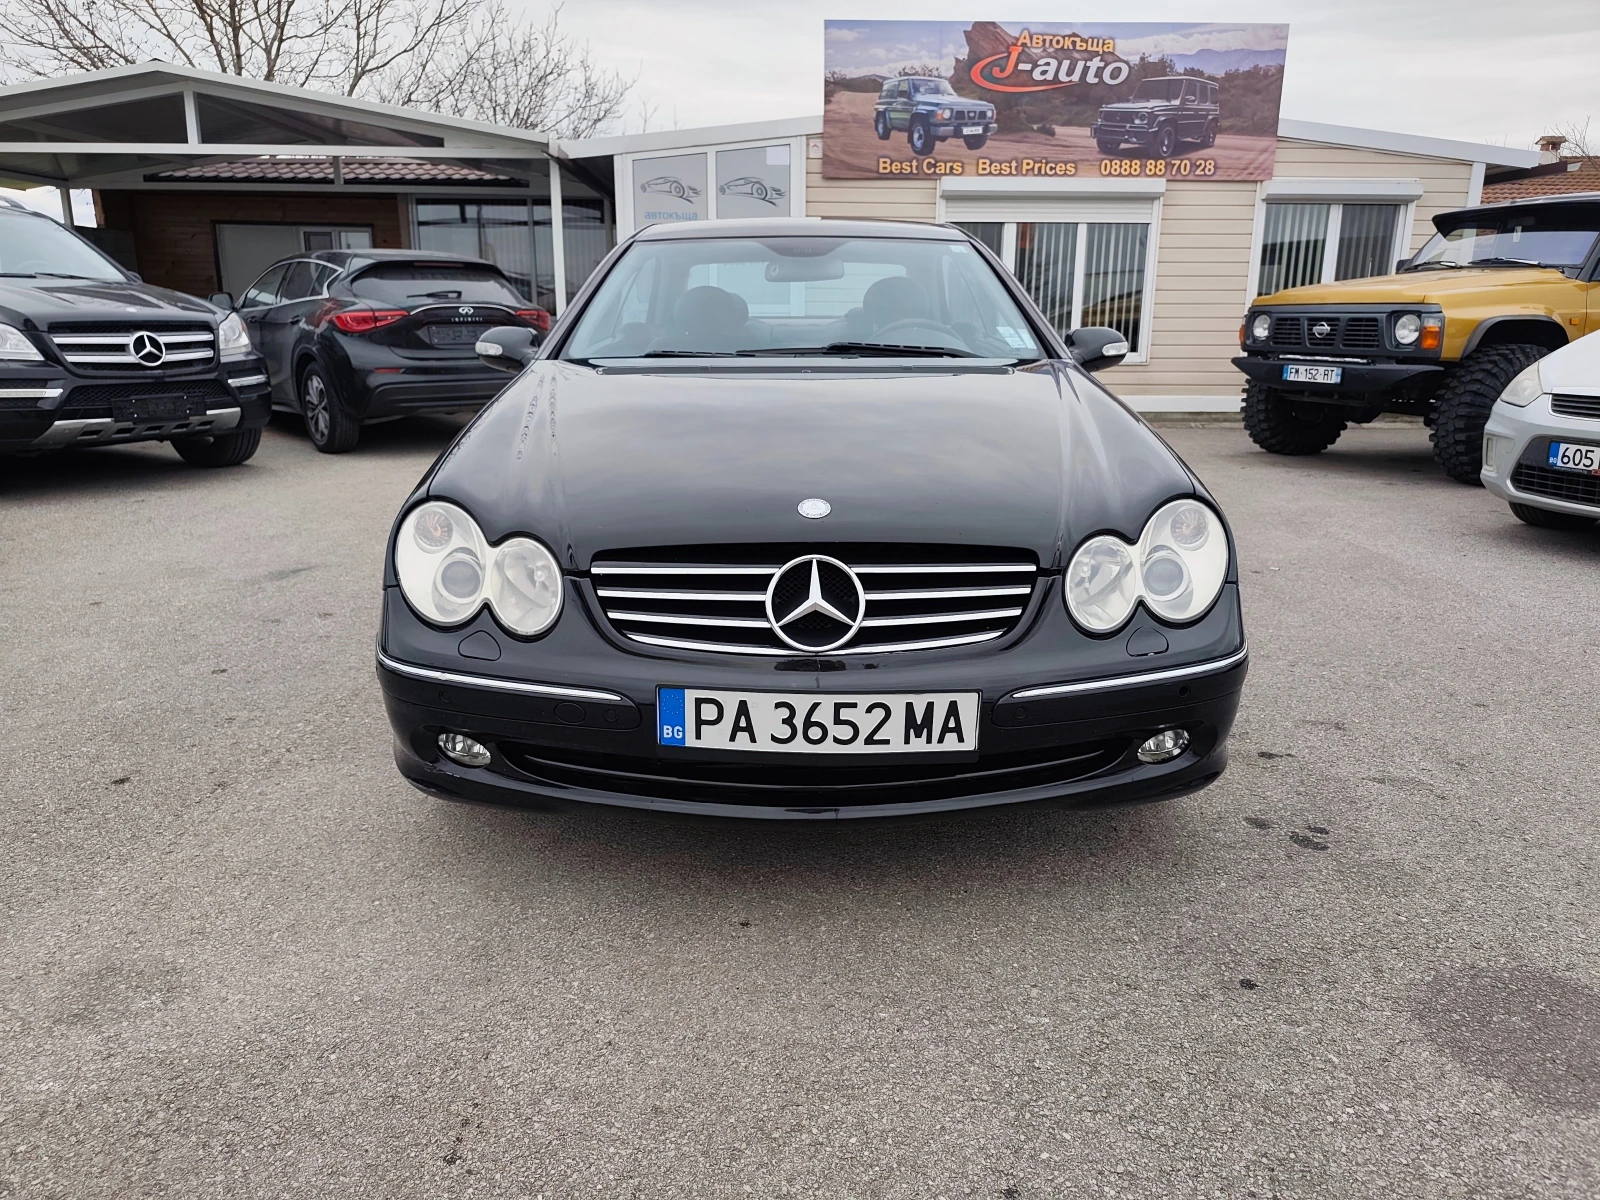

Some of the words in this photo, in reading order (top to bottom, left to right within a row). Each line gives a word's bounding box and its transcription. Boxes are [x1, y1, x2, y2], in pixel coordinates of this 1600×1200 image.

[1017, 30, 1114, 54] Автокъща
[991, 45, 1130, 85] J-auto
[878, 158, 918, 174] Best
[922, 158, 963, 174] Cars
[977, 158, 1017, 174] Best
[1022, 159, 1076, 175] Prices
[1100, 159, 1141, 175] 0888
[1145, 159, 1166, 175] 88
[1171, 159, 1191, 175] 70
[1195, 159, 1215, 175] 28
[644, 211, 698, 221] автокъща
[1560, 447, 1595, 468] 605
[694, 697, 757, 743] PA
[770, 701, 892, 745] 3652
[903, 700, 965, 745] MA
[663, 725, 683, 739] BG
